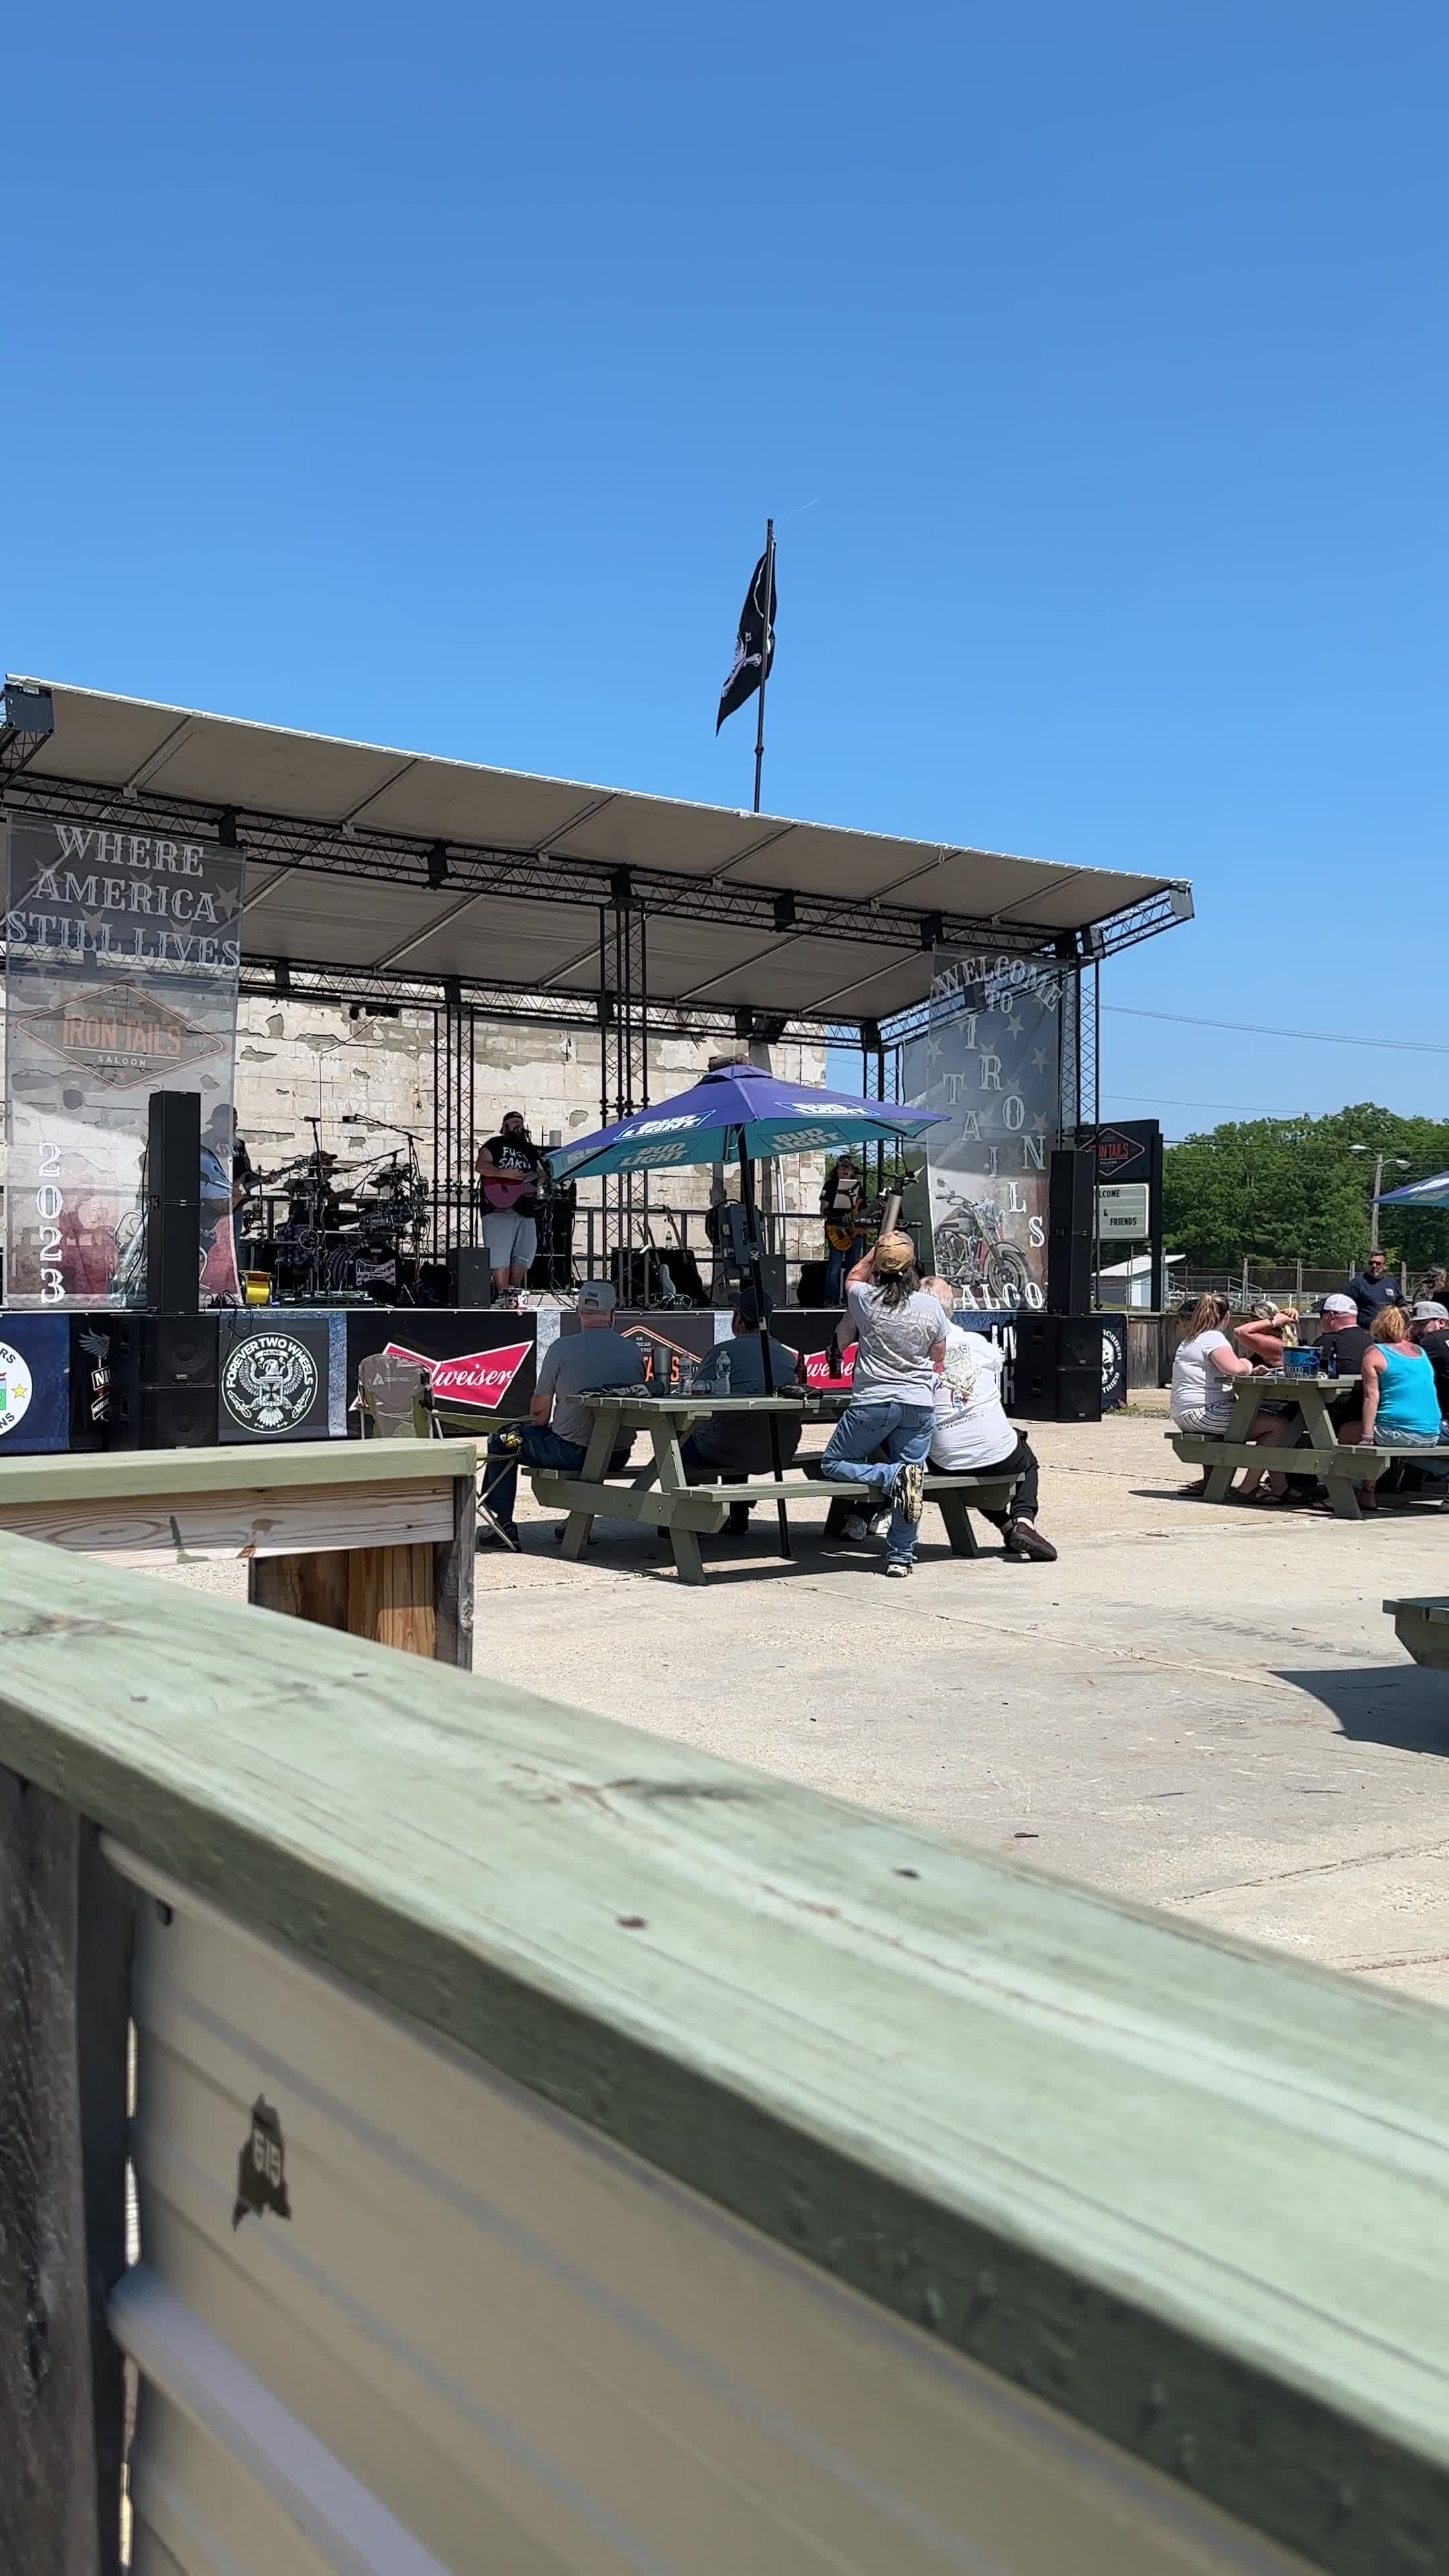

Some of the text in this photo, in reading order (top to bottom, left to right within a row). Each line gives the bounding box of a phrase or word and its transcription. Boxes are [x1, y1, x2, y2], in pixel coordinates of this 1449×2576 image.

[53, 823, 205, 878] WHERE
[32, 869, 220, 924] AMERICA
[7, 910, 241, 968] STILL LIVES
[933, 955, 1063, 1012] WELCOME
[985, 987, 1014, 1014] TO
[62, 1017, 182, 1057] IRON TAILS
[97, 1055, 147, 1067] SALOON
[639, 1142, 687, 1155] BUD
[771, 1132, 840, 1150] LIGHT
[772, 1128, 825, 1143] BUD
[619, 1150, 688, 1167] LIGHT
[1098, 1189, 1120, 1198] LCOME
[35, 1142, 66, 1304] 2023
[1110, 1217, 1137, 1226] FRIENDS
[953, 1281, 1044, 1310] ALOO
[226, 1337, 313, 1388] FOREVER TWO WHEELS
